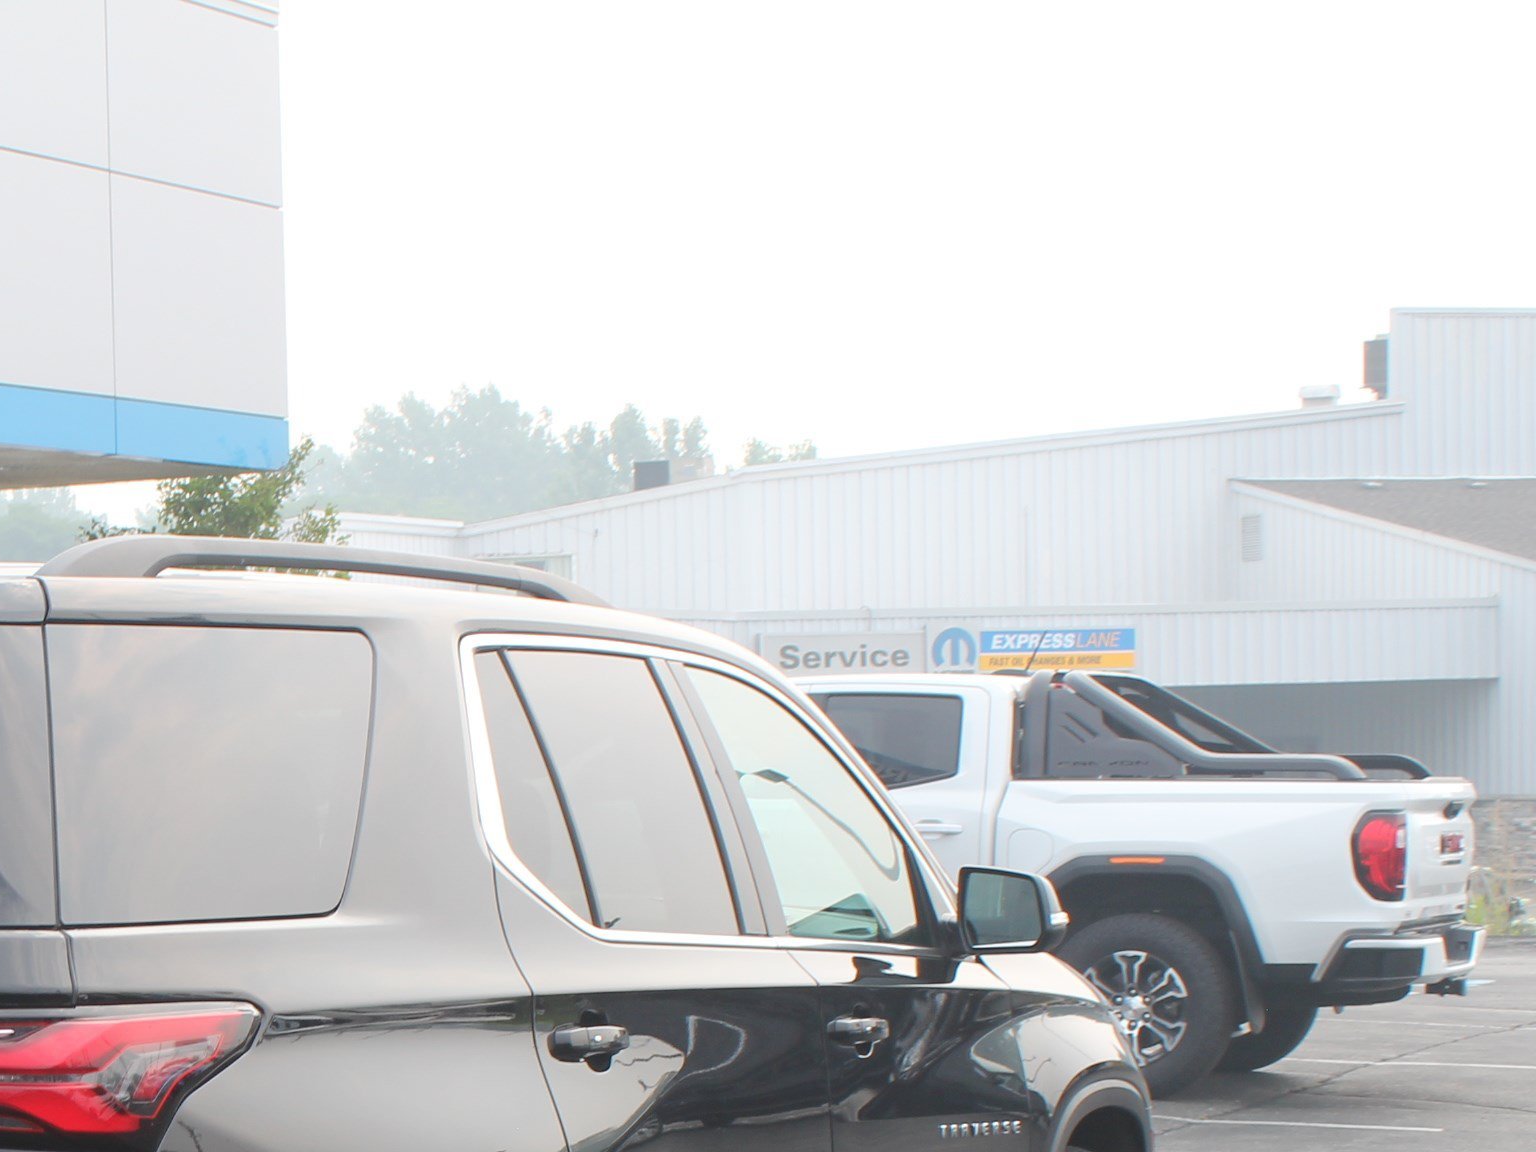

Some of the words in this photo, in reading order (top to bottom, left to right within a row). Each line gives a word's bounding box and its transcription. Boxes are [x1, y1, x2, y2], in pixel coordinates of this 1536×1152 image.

[779, 643, 910, 669] Service
[989, 657, 1008, 666] FAST
[939, 1120, 1023, 1138] TRAVERSE
